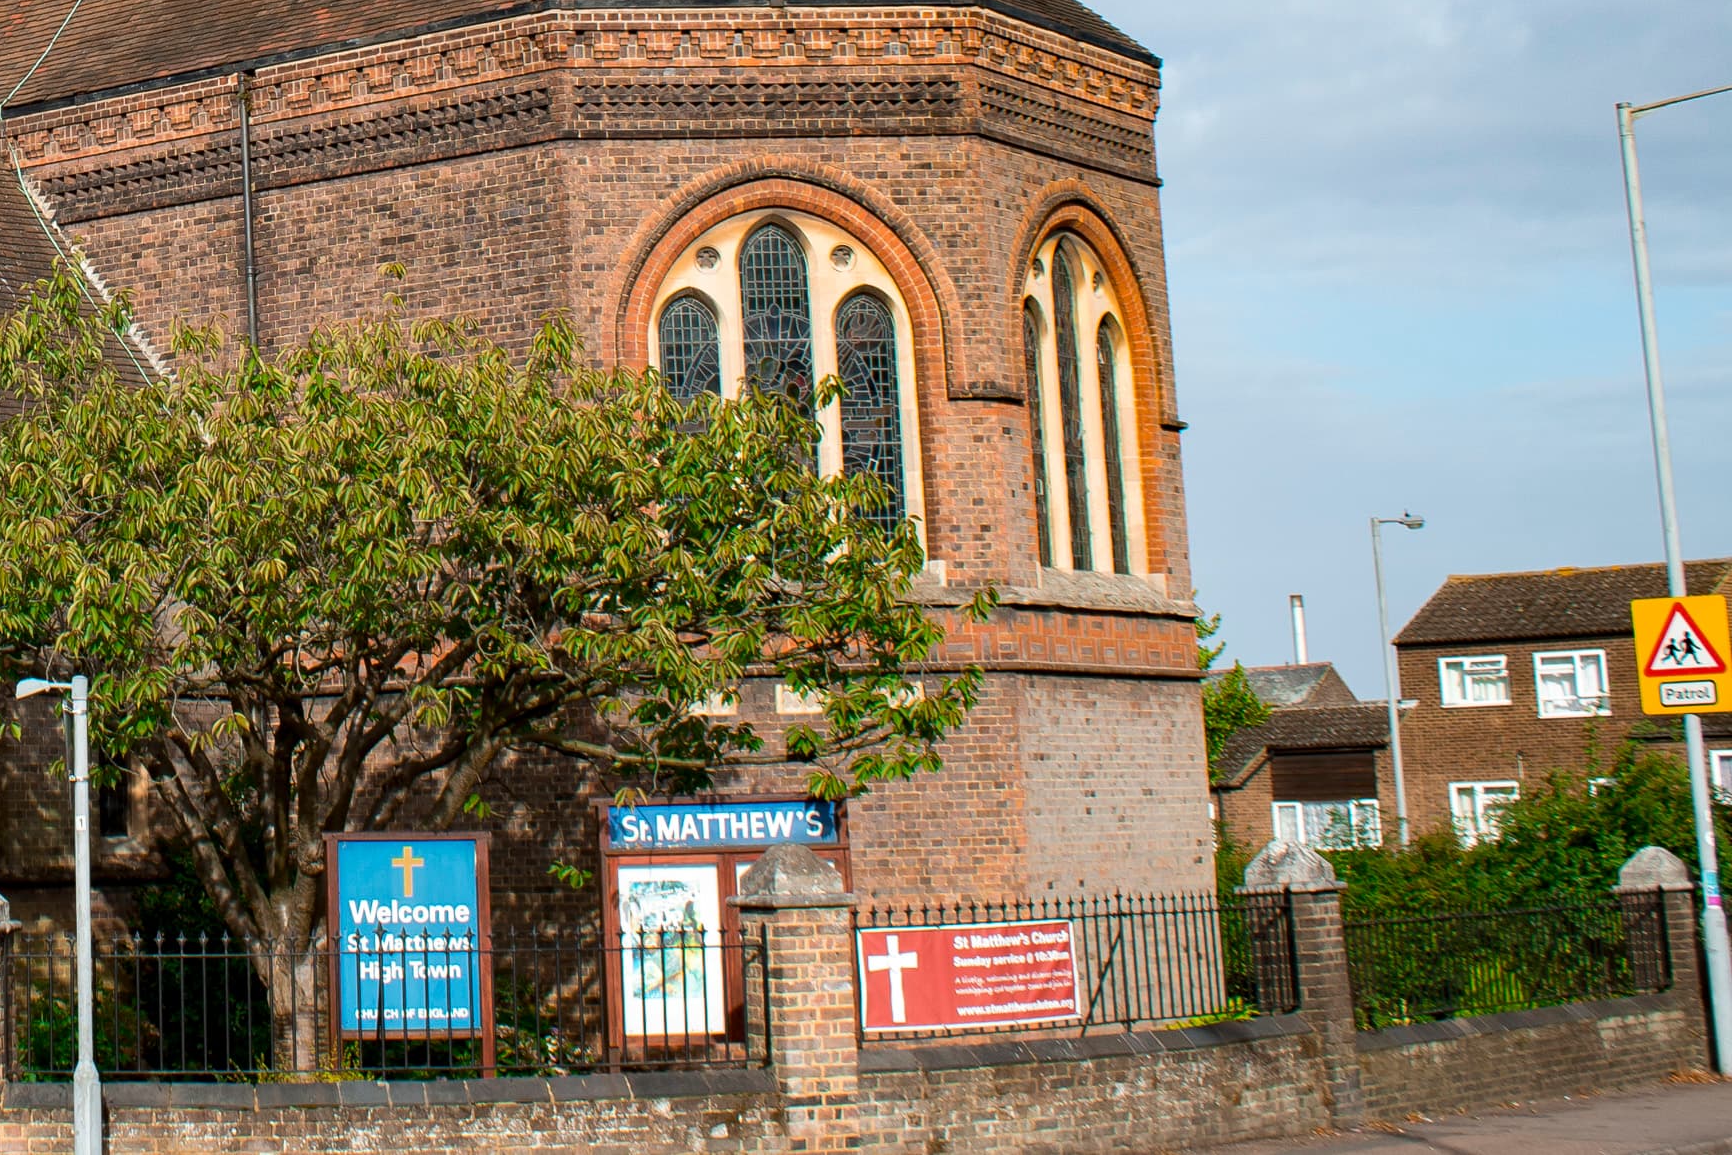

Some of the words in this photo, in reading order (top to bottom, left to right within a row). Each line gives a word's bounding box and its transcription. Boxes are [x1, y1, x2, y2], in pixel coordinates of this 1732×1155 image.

[1665, 686, 1711, 701] Patrol
[656, 810, 825, 842] MATTHEW'S
[349, 899, 470, 924] Welcome
[347, 933, 370, 952] St
[953, 935, 970, 950] St
[970, 932, 1030, 948] Matthew's
[1031, 930, 1068, 945] Church
[953, 955, 991, 968] Sunday
[992, 953, 1026, 965] service
[359, 960, 404, 984] High
[408, 959, 462, 979] Town
[354, 1008, 399, 1021] CHUCH
